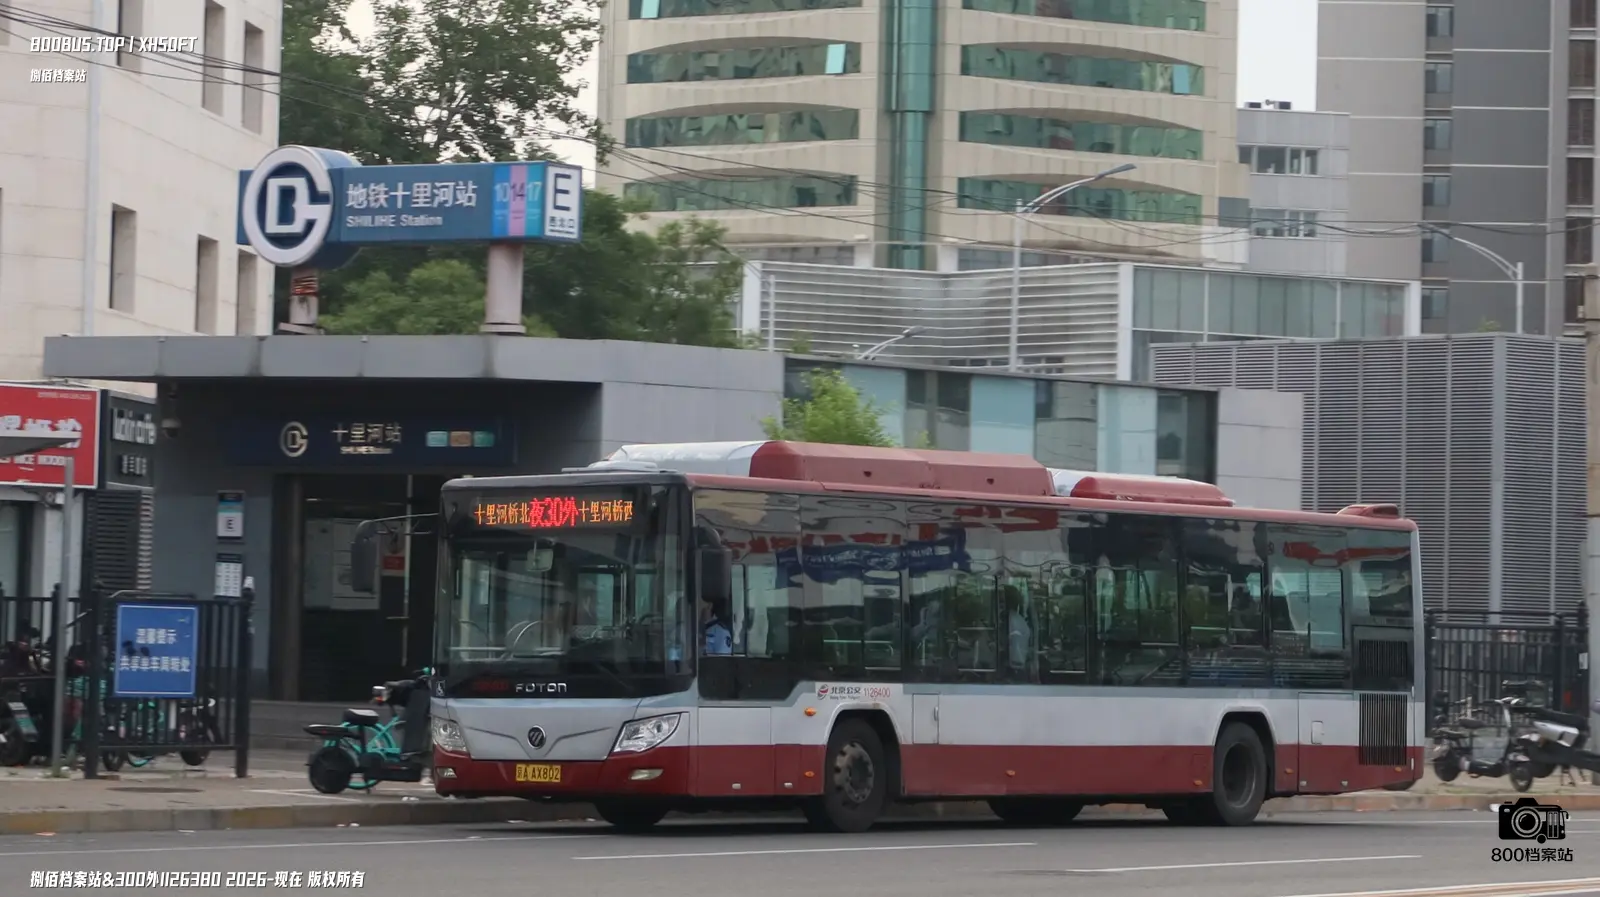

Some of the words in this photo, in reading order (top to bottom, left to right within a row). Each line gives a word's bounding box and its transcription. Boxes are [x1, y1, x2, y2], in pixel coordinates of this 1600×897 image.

[346, 181, 478, 209] 地铁十里河站
[494, 182, 510, 202] 10
[511, 182, 526, 202] 14
[527, 181, 542, 201] 17
[553, 173, 572, 211] E
[346, 214, 396, 227] SHILIHE
[399, 214, 443, 226] Station
[332, 422, 402, 443] 十里河站
[474, 503, 530, 525] 十里河桥北
[529, 497, 579, 528] 夜30外
[227, 519, 234, 530] E
[515, 683, 567, 693] FOTON
[830, 686, 861, 695] 北京公交
[864, 688, 891, 698] 1126400
